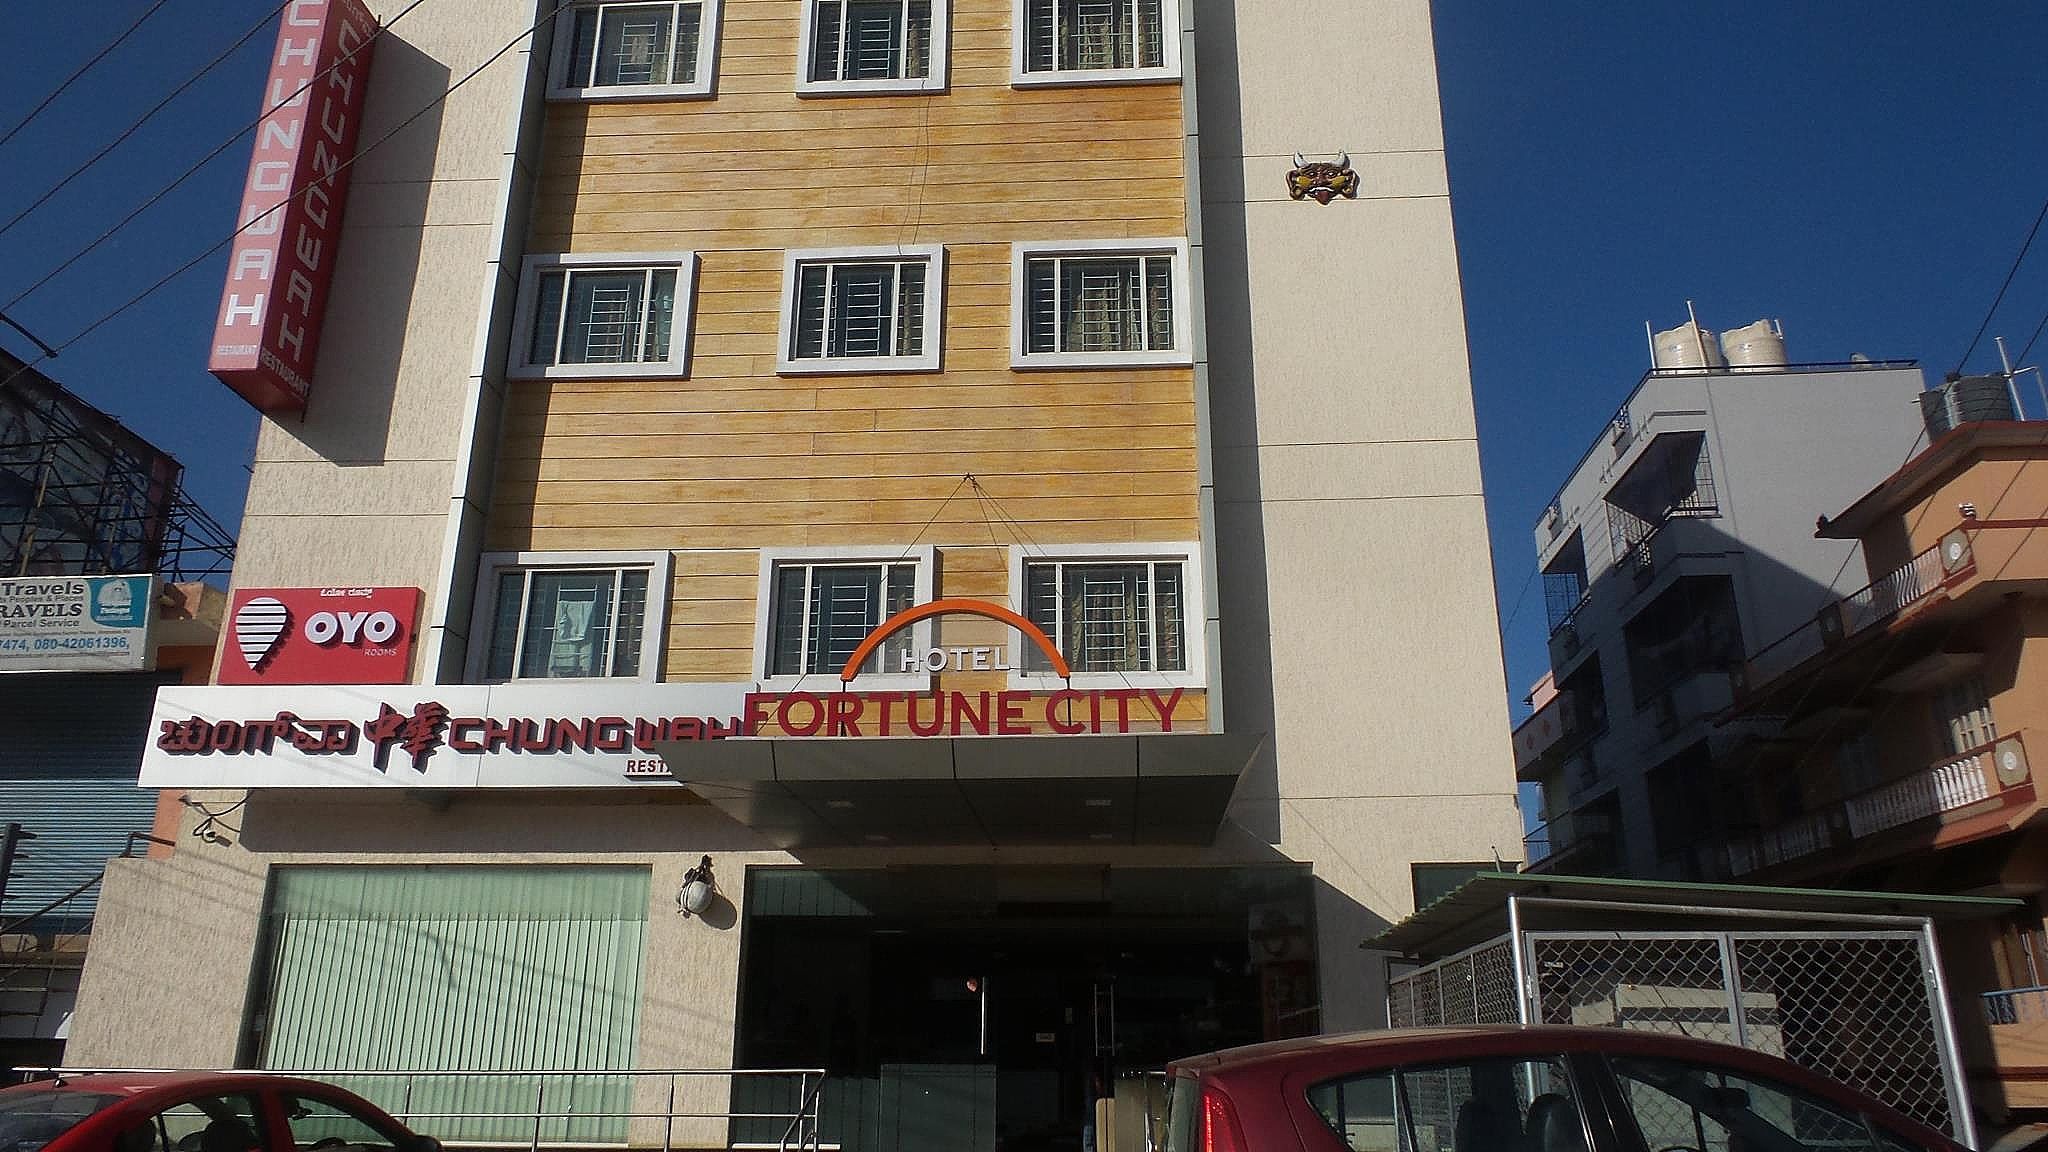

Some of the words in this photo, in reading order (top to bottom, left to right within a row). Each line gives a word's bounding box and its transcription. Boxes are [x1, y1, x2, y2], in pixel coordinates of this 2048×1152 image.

[224, 0, 324, 327] CHUNGWAH
[2, 581, 84, 596] Travels
[3, 620, 36, 628] Parcel
[39, 618, 80, 628] Service
[304, 611, 396, 643] OYO
[0, 640, 29, 652] 474,
[364, 648, 397, 657] ROOMS
[900, 647, 1011, 672] HOTEL
[744, 691, 1031, 737] FORTUNE
[1045, 688, 1184, 734] CITY
[363, 701, 447, 774] 中華
[626, 760, 670, 773] REST
